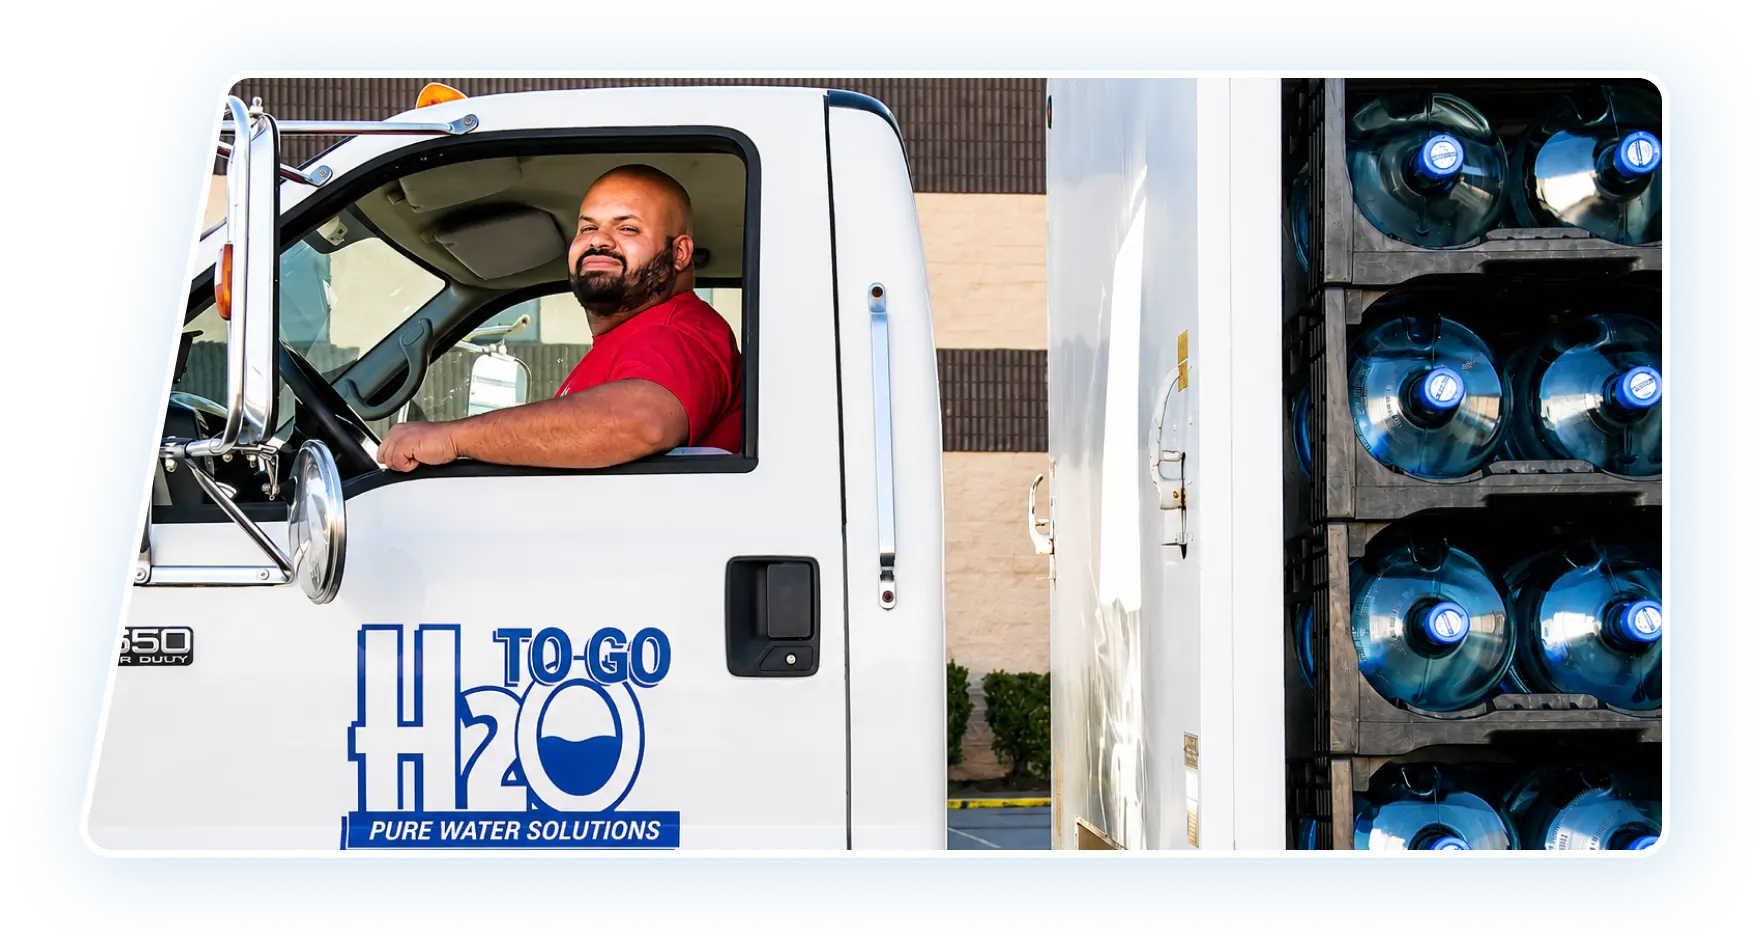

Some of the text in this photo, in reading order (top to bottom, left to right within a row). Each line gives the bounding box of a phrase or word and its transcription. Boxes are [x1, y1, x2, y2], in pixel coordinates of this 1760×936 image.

[493, 626, 672, 687] TO-GO
[348, 623, 646, 812] H2O
[369, 821, 661, 840] PURE WATER SOLUTIONS
